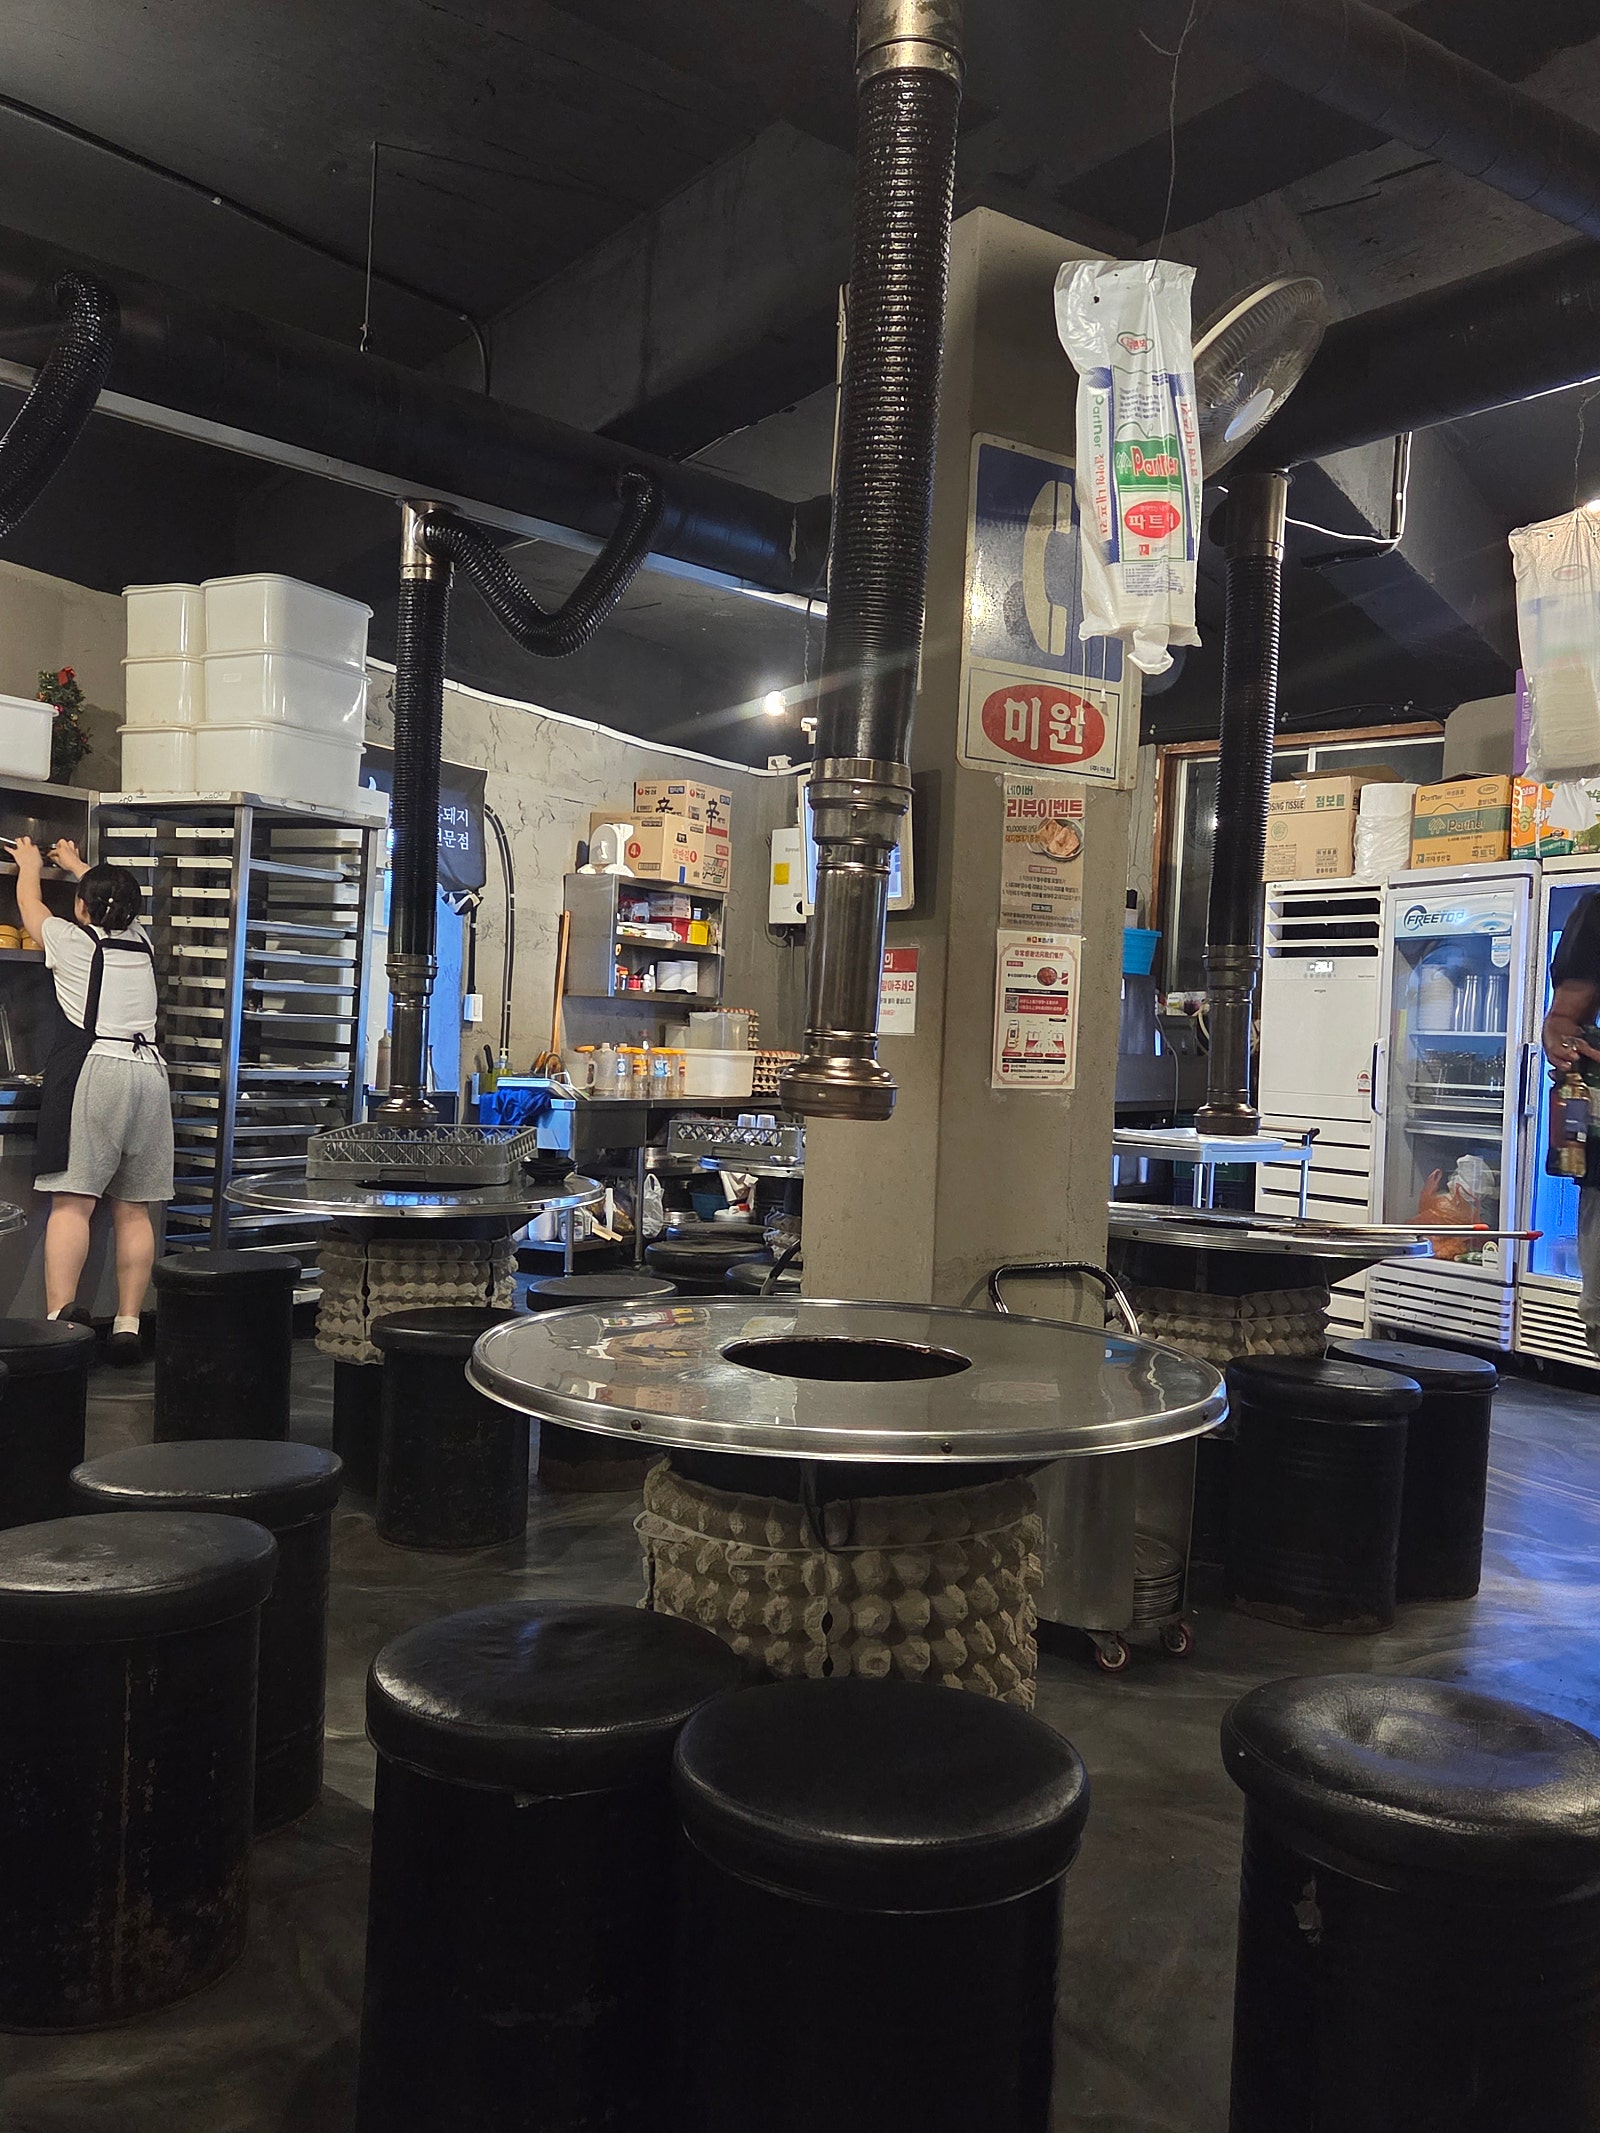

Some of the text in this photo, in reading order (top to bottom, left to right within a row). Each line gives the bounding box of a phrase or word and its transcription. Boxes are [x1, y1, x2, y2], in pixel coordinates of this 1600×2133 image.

[1003, 696, 1085, 755] 미원
[1006, 785, 1033, 796] 네이버
[1007, 798, 1083, 818] 리뷰이벤트
[1285, 800, 1304, 810] TISSUE
[438, 805, 469, 827] 돼지
[1406, 911, 1465, 926] FREETOP
